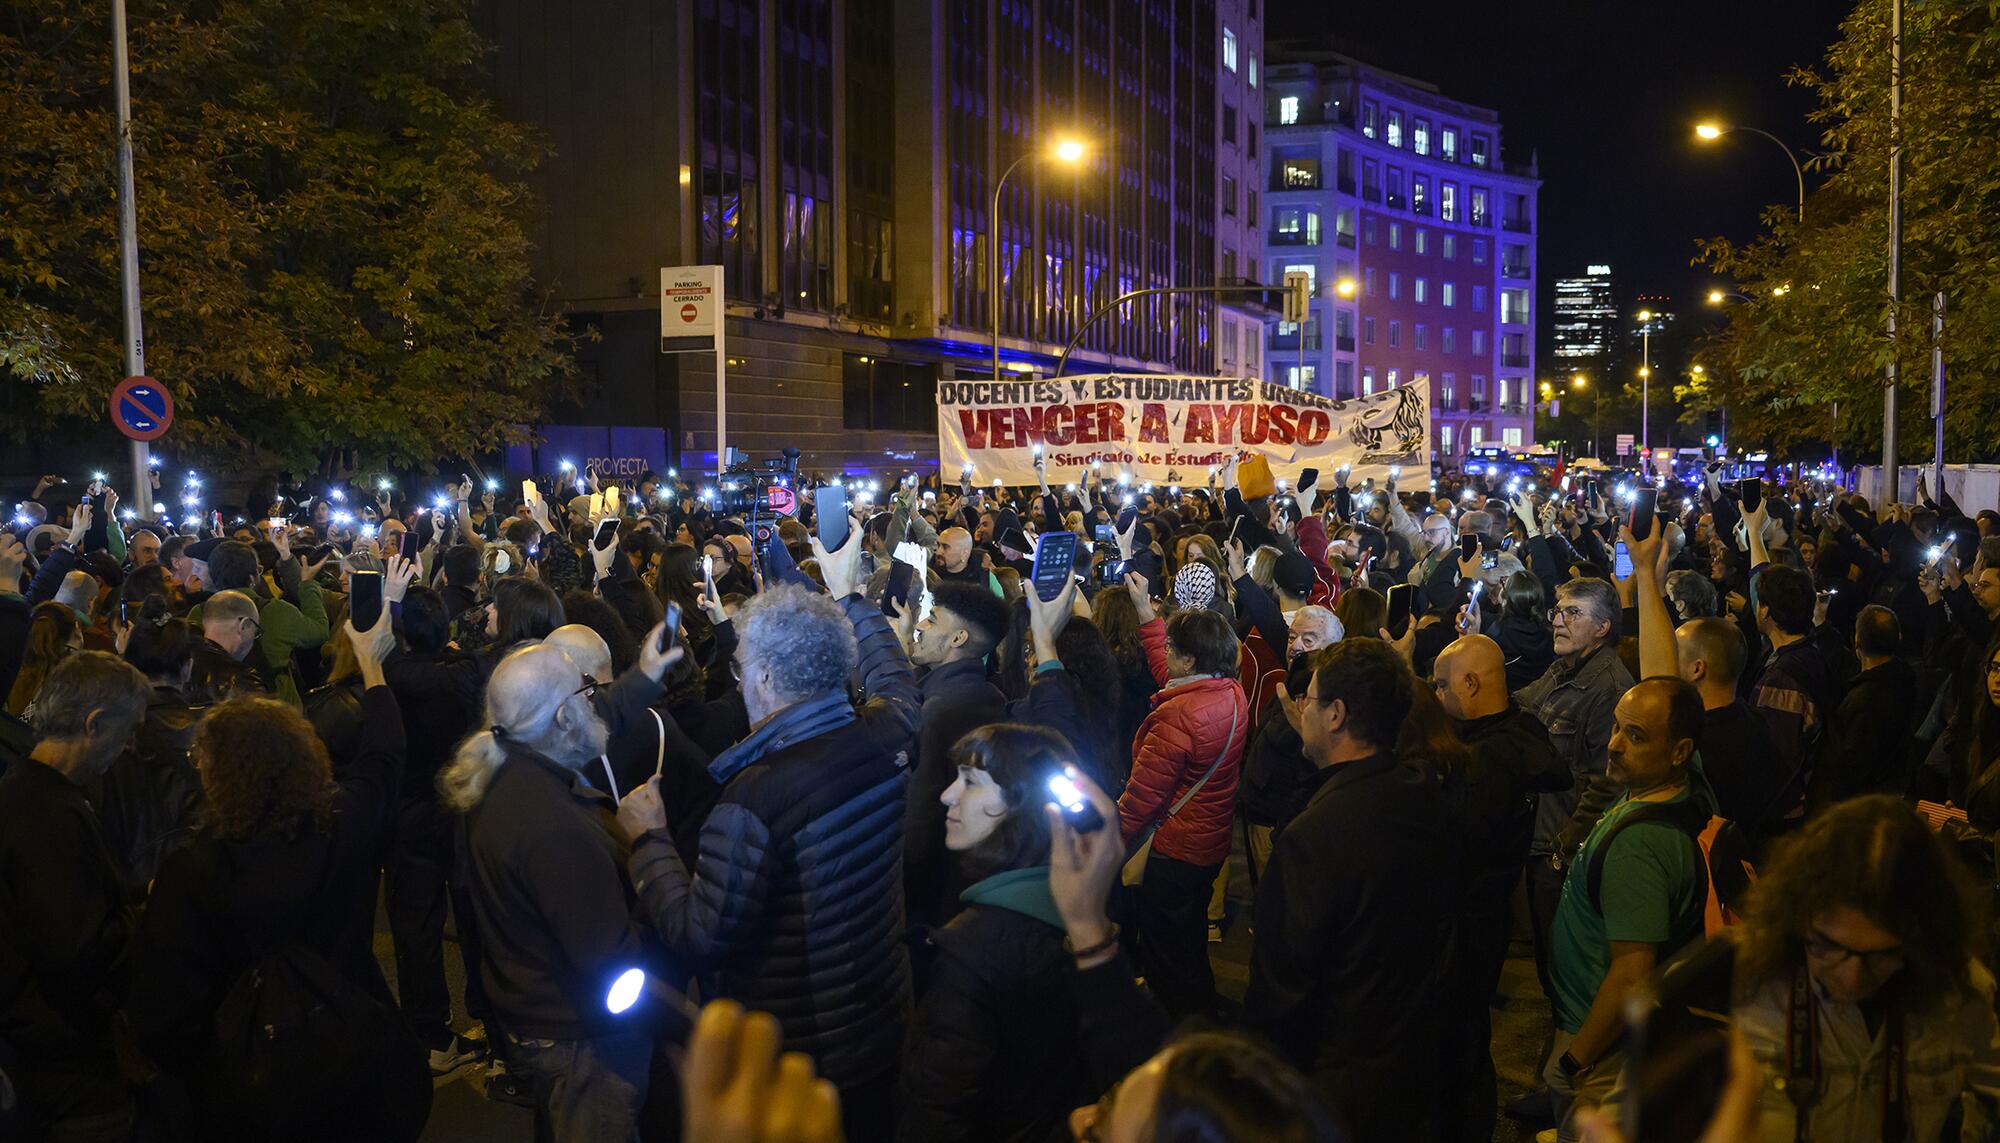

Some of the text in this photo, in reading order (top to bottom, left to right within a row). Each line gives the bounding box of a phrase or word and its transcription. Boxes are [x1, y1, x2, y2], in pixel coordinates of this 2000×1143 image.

[940, 381, 1063, 405] DOCENTES
[1070, 379, 1087, 400] Y
[1094, 375, 1254, 401] ESTUDIANTES
[958, 401, 1331, 449] VENCER A AYUSO
[587, 457, 649, 475] PROYECTA
[1055, 451, 1133, 467] Sindicato
[1137, 453, 1162, 464] de
